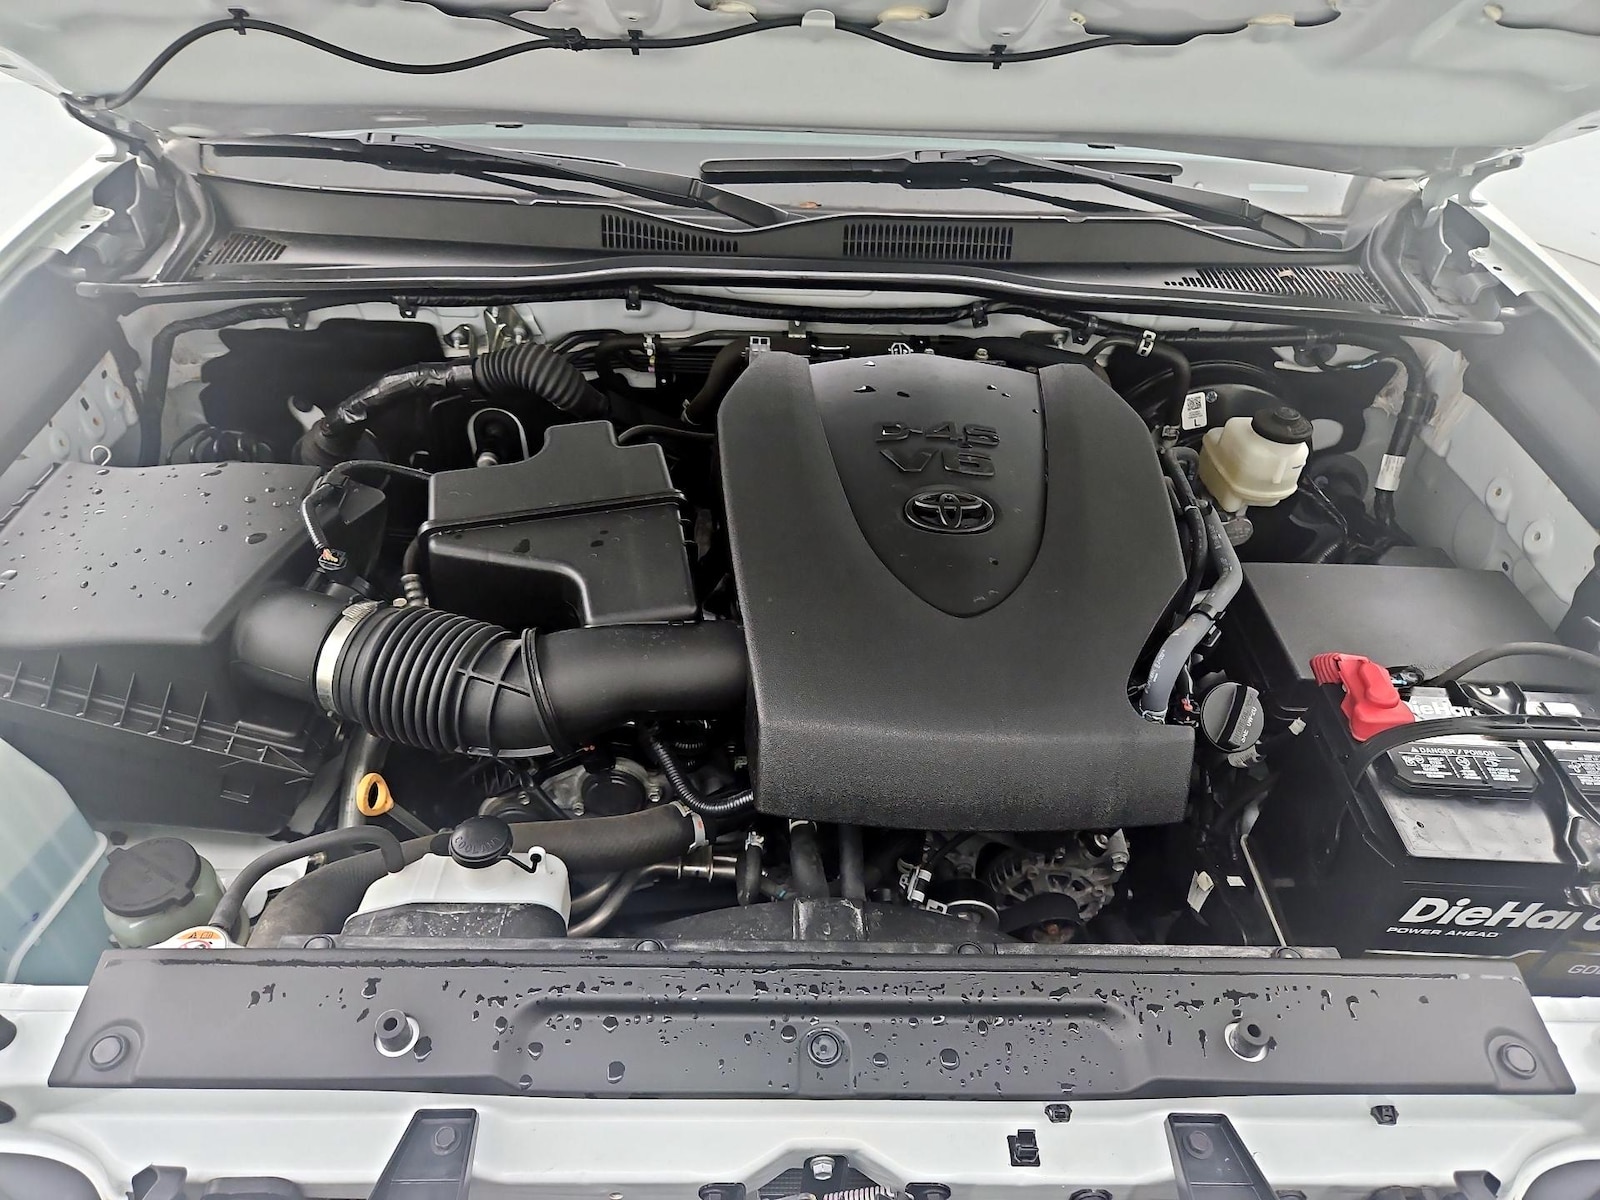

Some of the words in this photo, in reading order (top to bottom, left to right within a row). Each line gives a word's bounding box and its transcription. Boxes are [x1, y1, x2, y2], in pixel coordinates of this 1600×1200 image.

[874, 421, 1000, 447] D-4S
[878, 447, 996, 477] V6
[1419, 746, 1457, 756] DANGER
[1463, 748, 1497, 757] POISON
[455, 836, 501, 854] COOLANT
[1386, 926, 1443, 936] POWER
[1444, 929, 1500, 939] AHEAD
